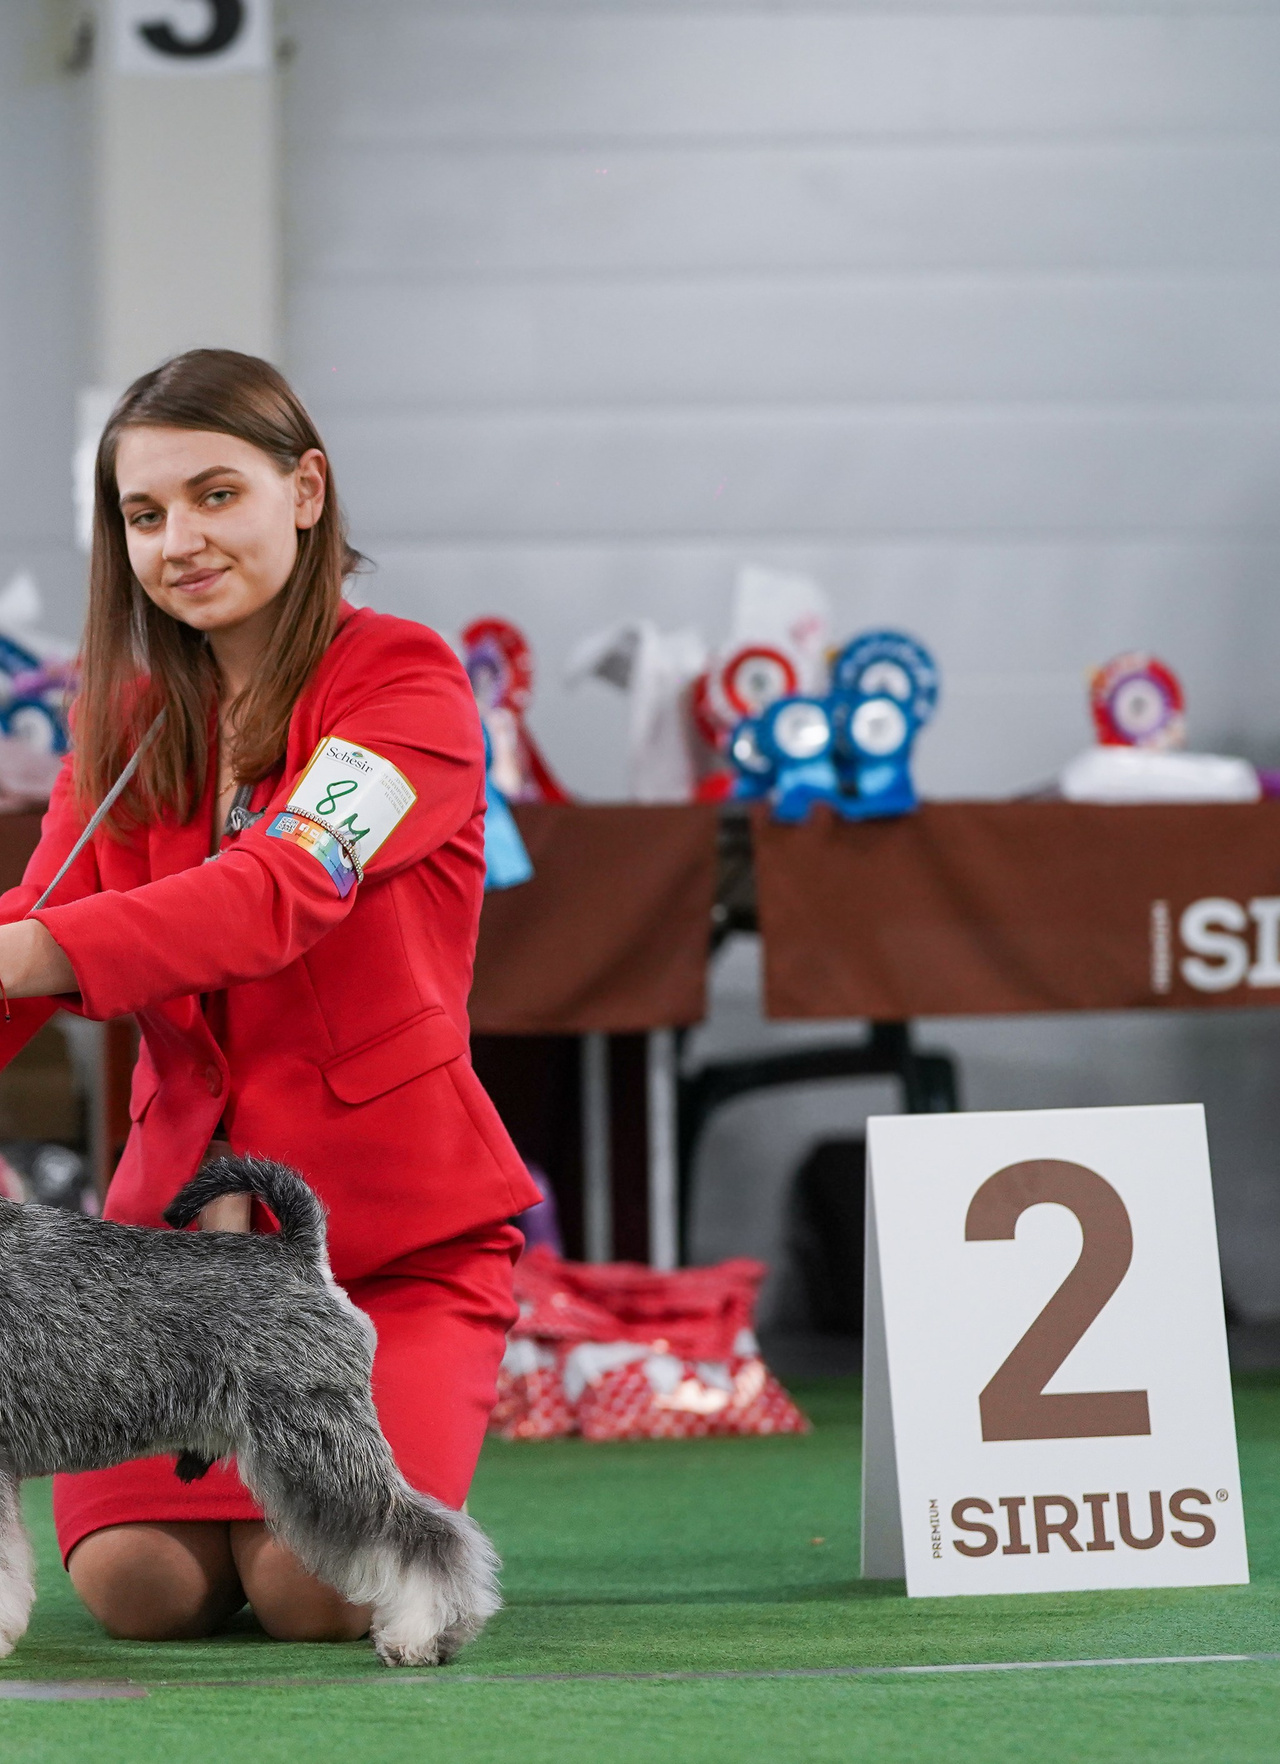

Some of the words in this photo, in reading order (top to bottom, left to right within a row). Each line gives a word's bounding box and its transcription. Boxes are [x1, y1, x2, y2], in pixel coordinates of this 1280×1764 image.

[326, 746, 373, 773] Schesir
[315, 780, 358, 815] 8
[964, 1158, 1152, 1443] 2
[928, 1498, 943, 1560] PREMIUM
